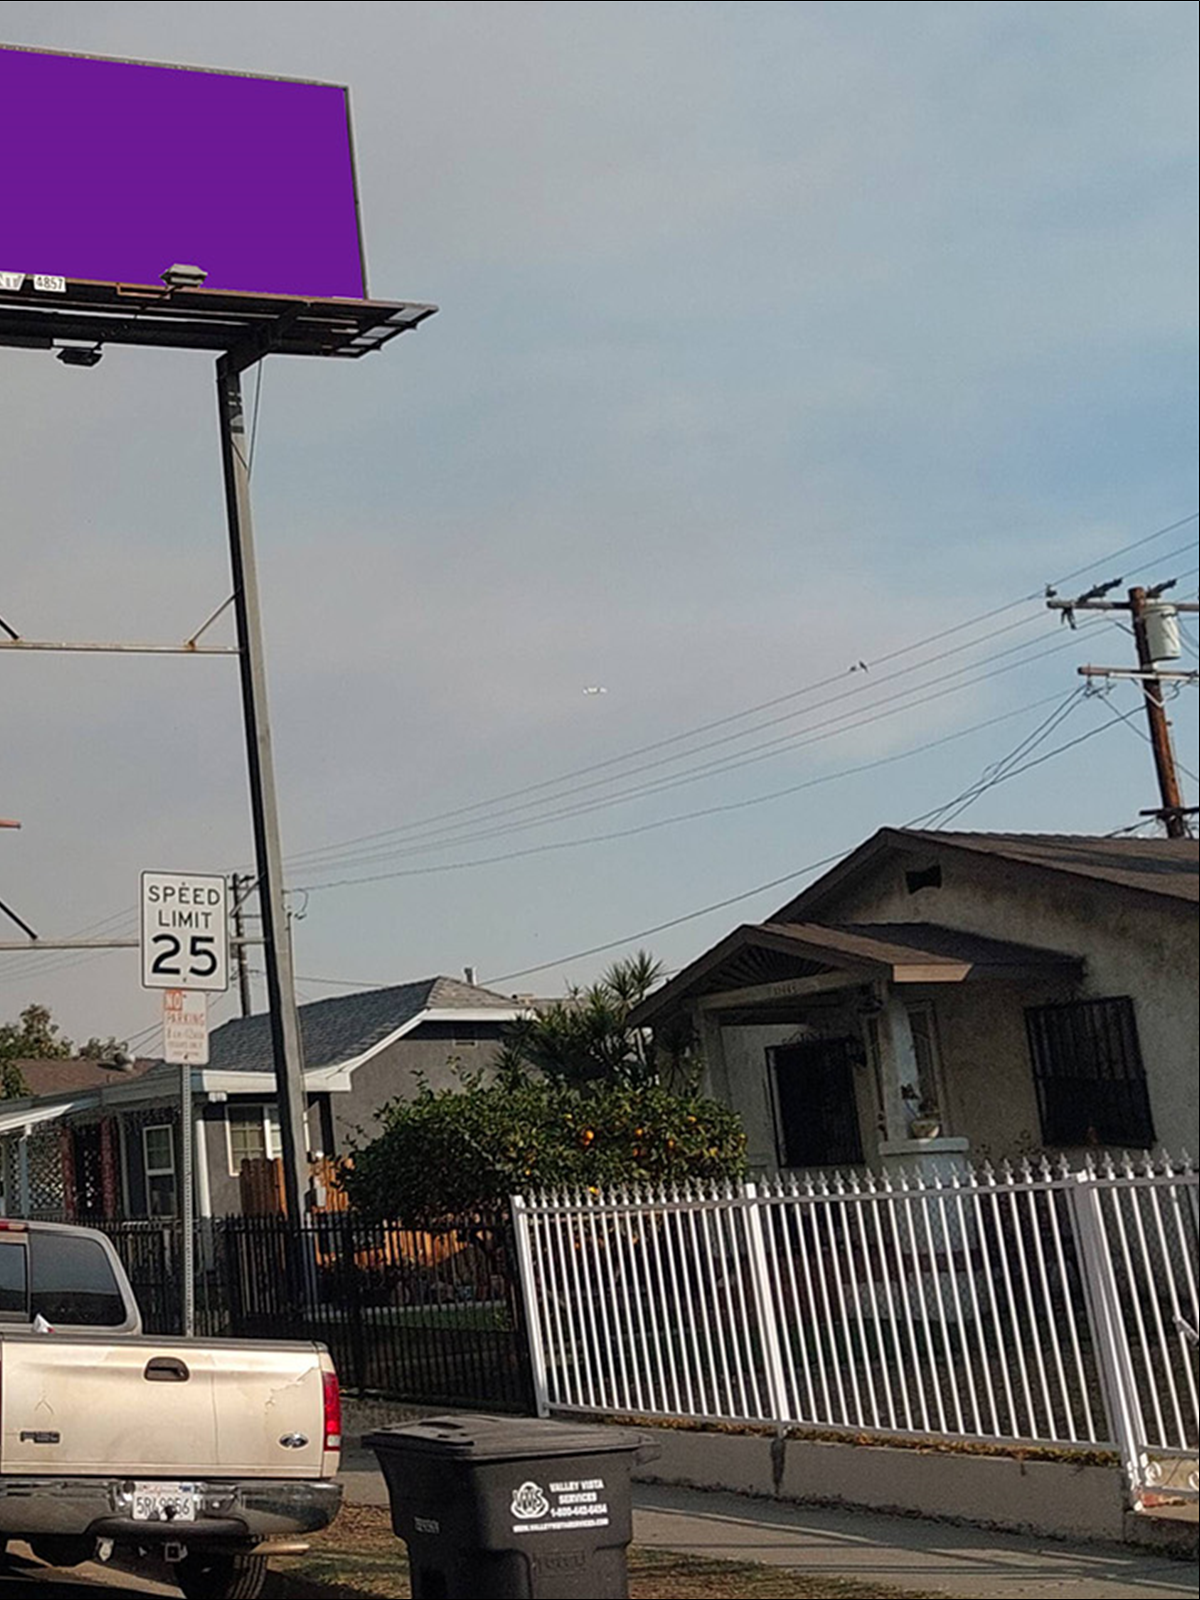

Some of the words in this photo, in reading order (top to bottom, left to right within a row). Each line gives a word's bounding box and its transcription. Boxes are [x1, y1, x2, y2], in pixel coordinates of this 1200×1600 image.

[36, 276, 64, 290] 4857
[148, 885, 220, 905] SPEED
[158, 909, 212, 929] LIMIT
[151, 933, 218, 977] 25
[165, 991, 182, 1010] NO
[166, 1011, 205, 1026] PARKING
[549, 1481, 579, 1493] VALLEY
[581, 1479, 605, 1490] VISTA
